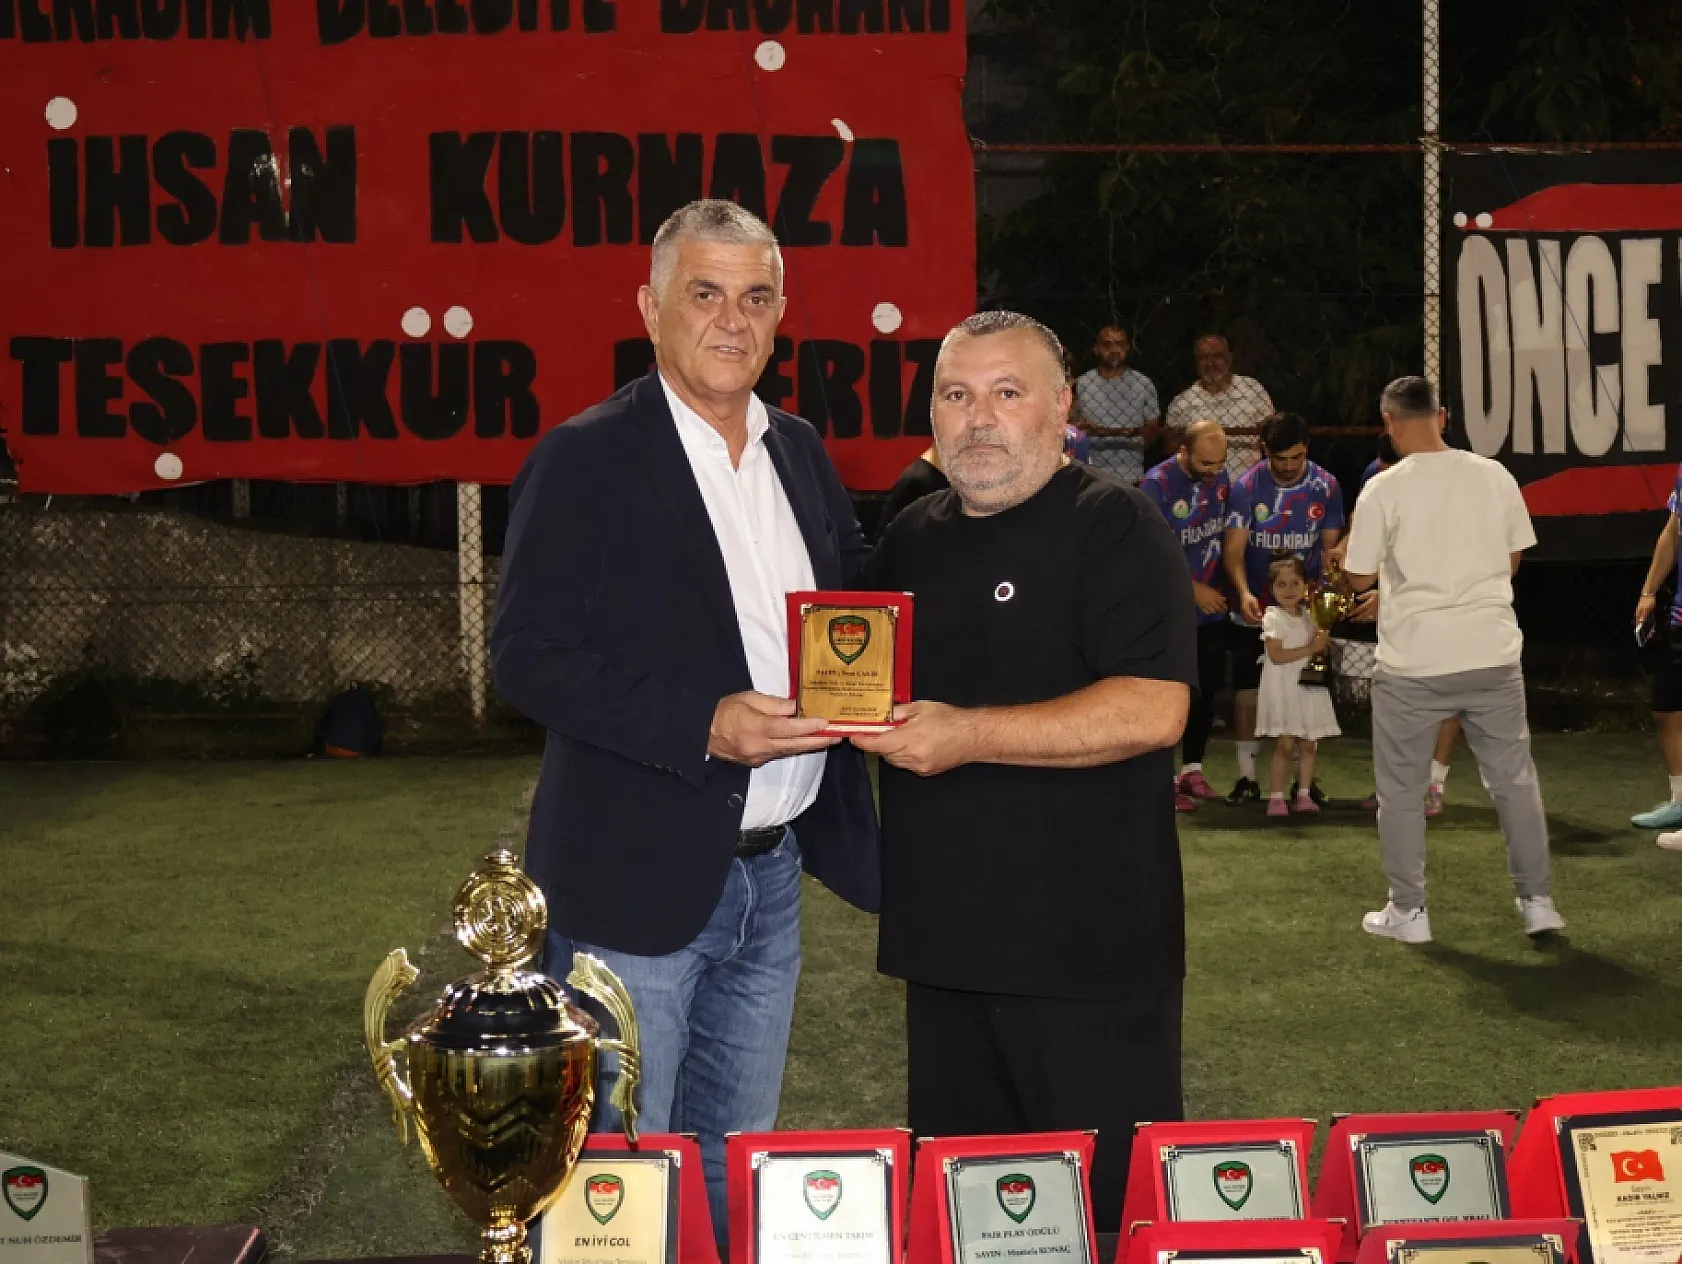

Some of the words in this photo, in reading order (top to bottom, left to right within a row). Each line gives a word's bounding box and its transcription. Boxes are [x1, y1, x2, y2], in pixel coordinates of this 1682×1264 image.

[45, 96, 356, 248] İHSAN
[10, 305, 541, 480] TEŞEKKÜR
[1454, 211, 1666, 458] ÖNCE
